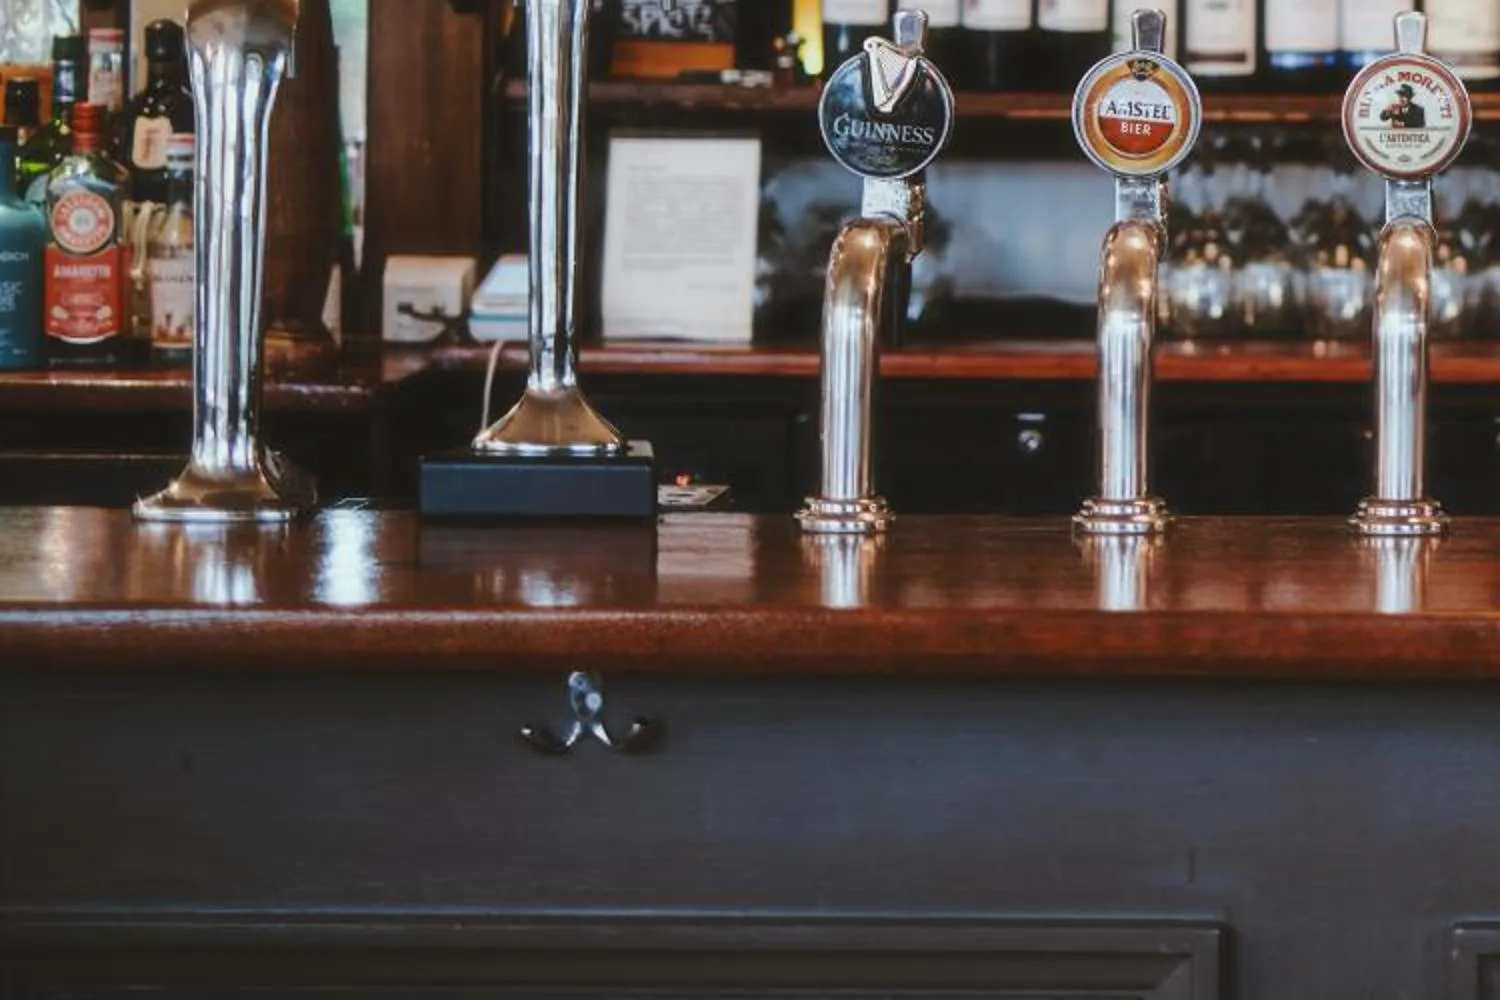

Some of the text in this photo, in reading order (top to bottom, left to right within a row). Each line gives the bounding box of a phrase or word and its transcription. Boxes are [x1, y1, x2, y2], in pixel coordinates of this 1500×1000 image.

[1105, 100, 1172, 119] AMSTEL
[833, 112, 936, 145] GUINNESS
[1120, 121, 1152, 136] BIER
